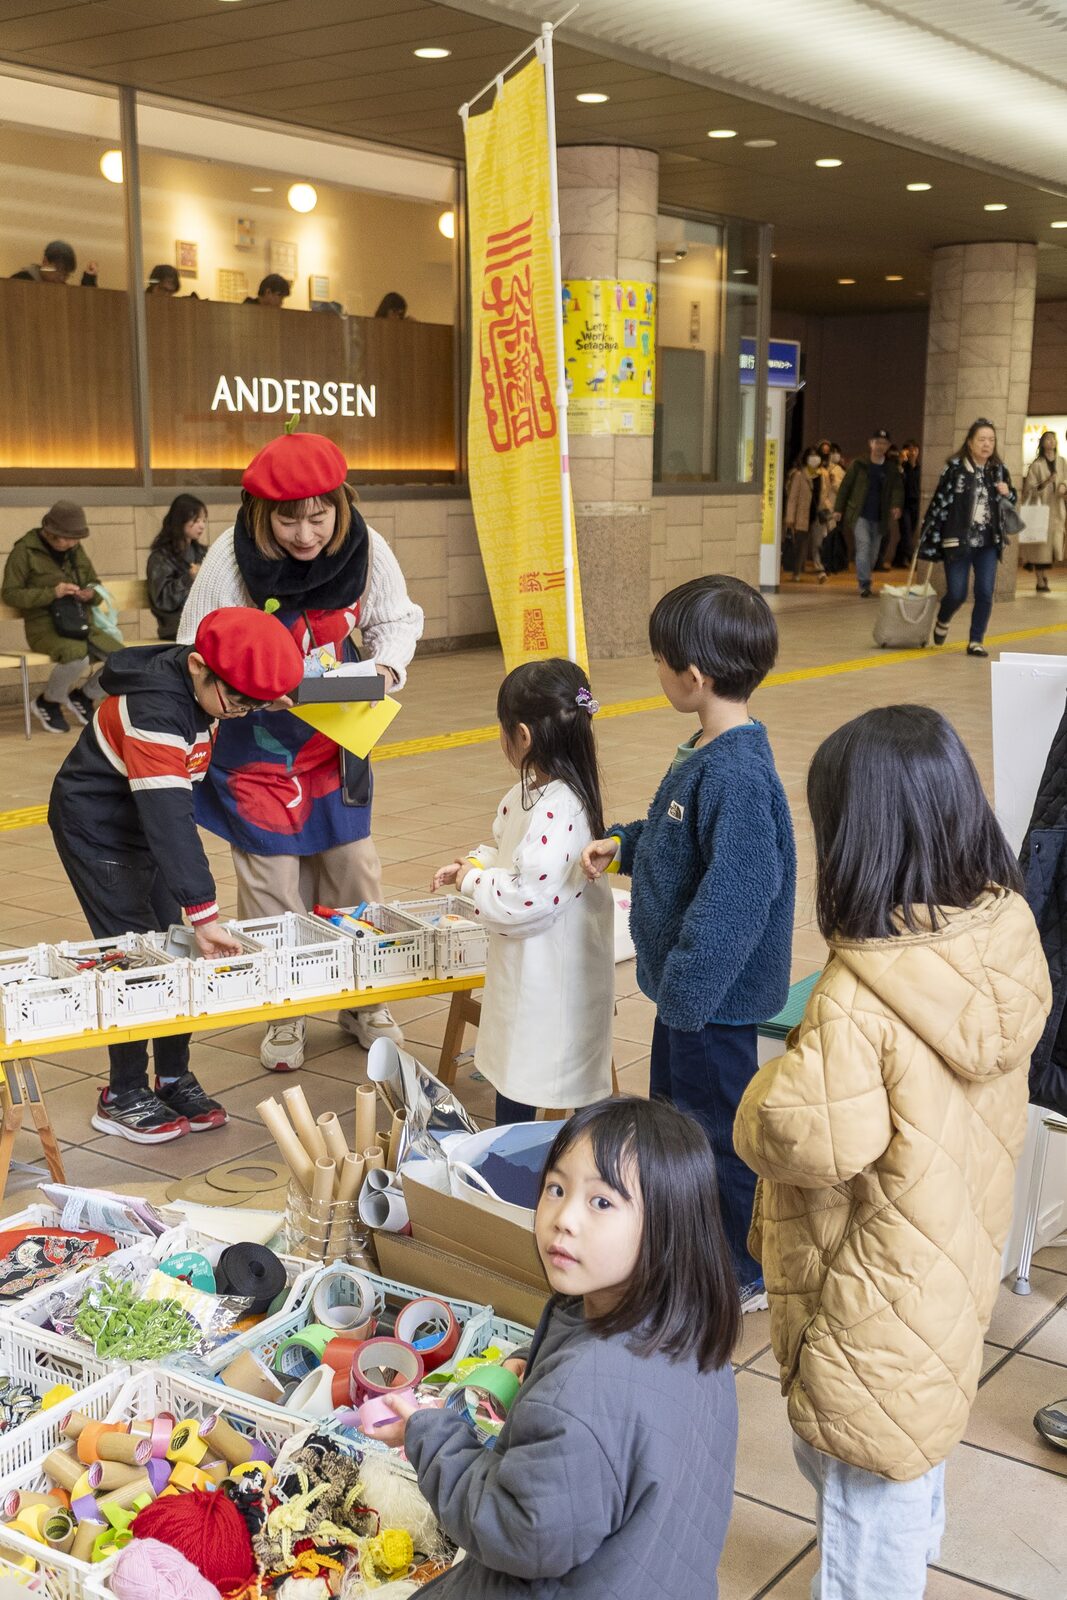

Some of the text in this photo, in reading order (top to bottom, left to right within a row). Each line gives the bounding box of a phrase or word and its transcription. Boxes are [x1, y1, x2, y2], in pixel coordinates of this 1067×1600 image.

[585, 320, 608, 332] Let's
[581, 331, 609, 342] Work
[576, 339, 619, 352] Setagaya
[211, 375, 376, 418] ANDERSEN
